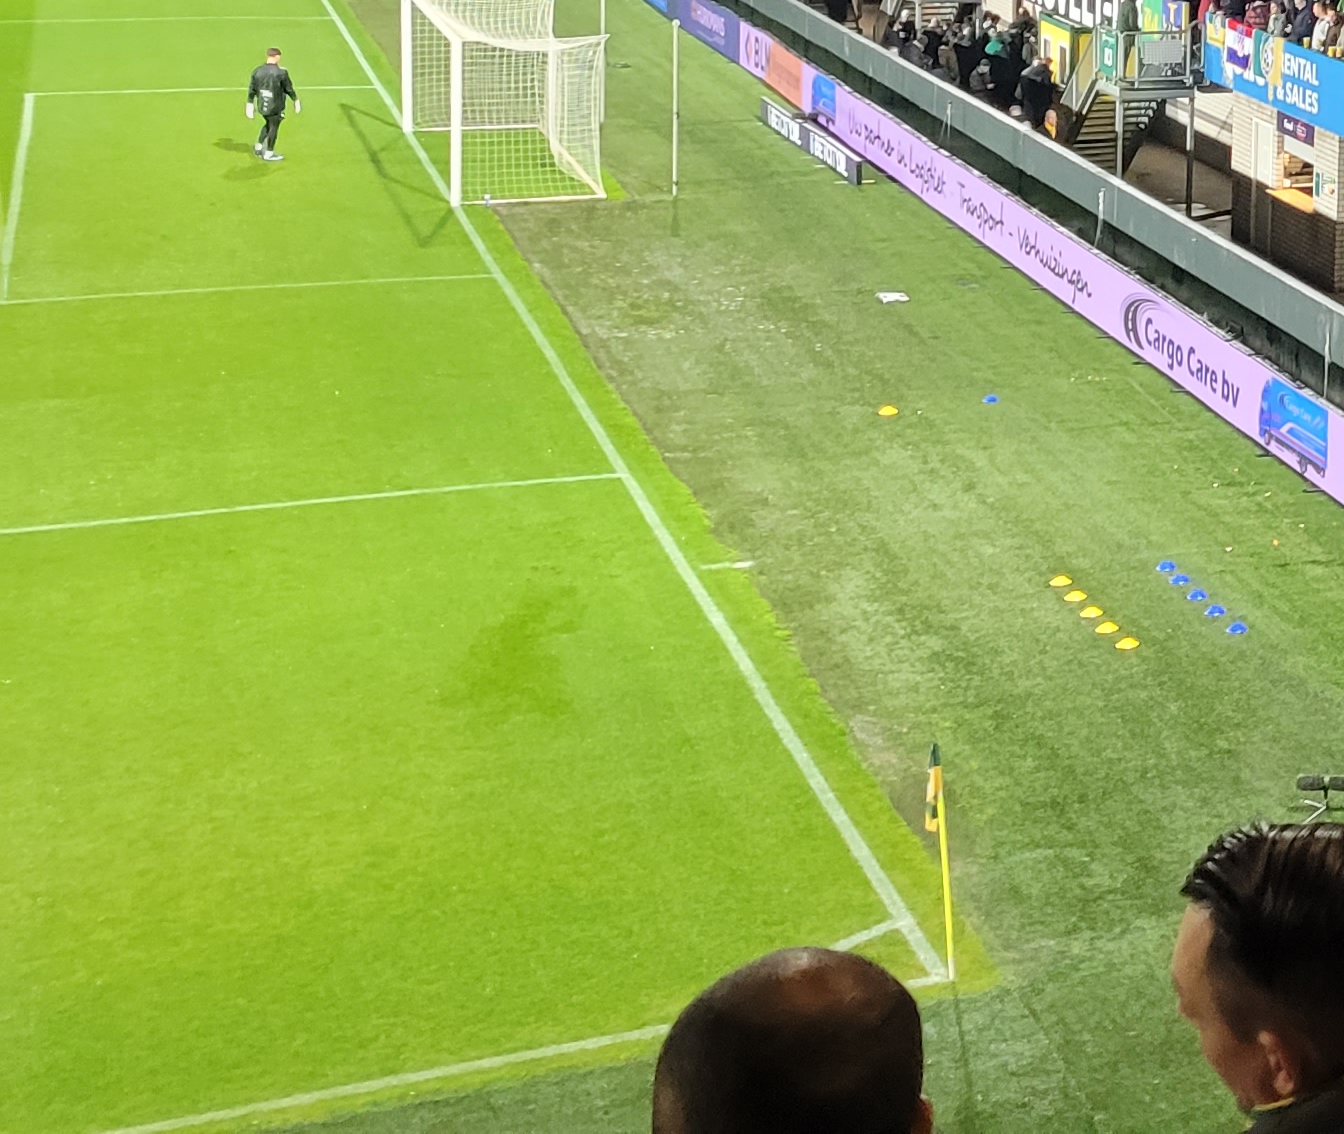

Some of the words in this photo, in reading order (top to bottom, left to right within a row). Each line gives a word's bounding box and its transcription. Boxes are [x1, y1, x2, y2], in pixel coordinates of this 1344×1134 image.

[1286, 81, 1319, 115] SALES
[956, 180, 1005, 238] Transport
[1018, 225, 1093, 304] Verhuizingen
[1144, 317, 1184, 371] Cargo
[1187, 345, 1218, 393] Care
[1221, 369, 1240, 408] bv
